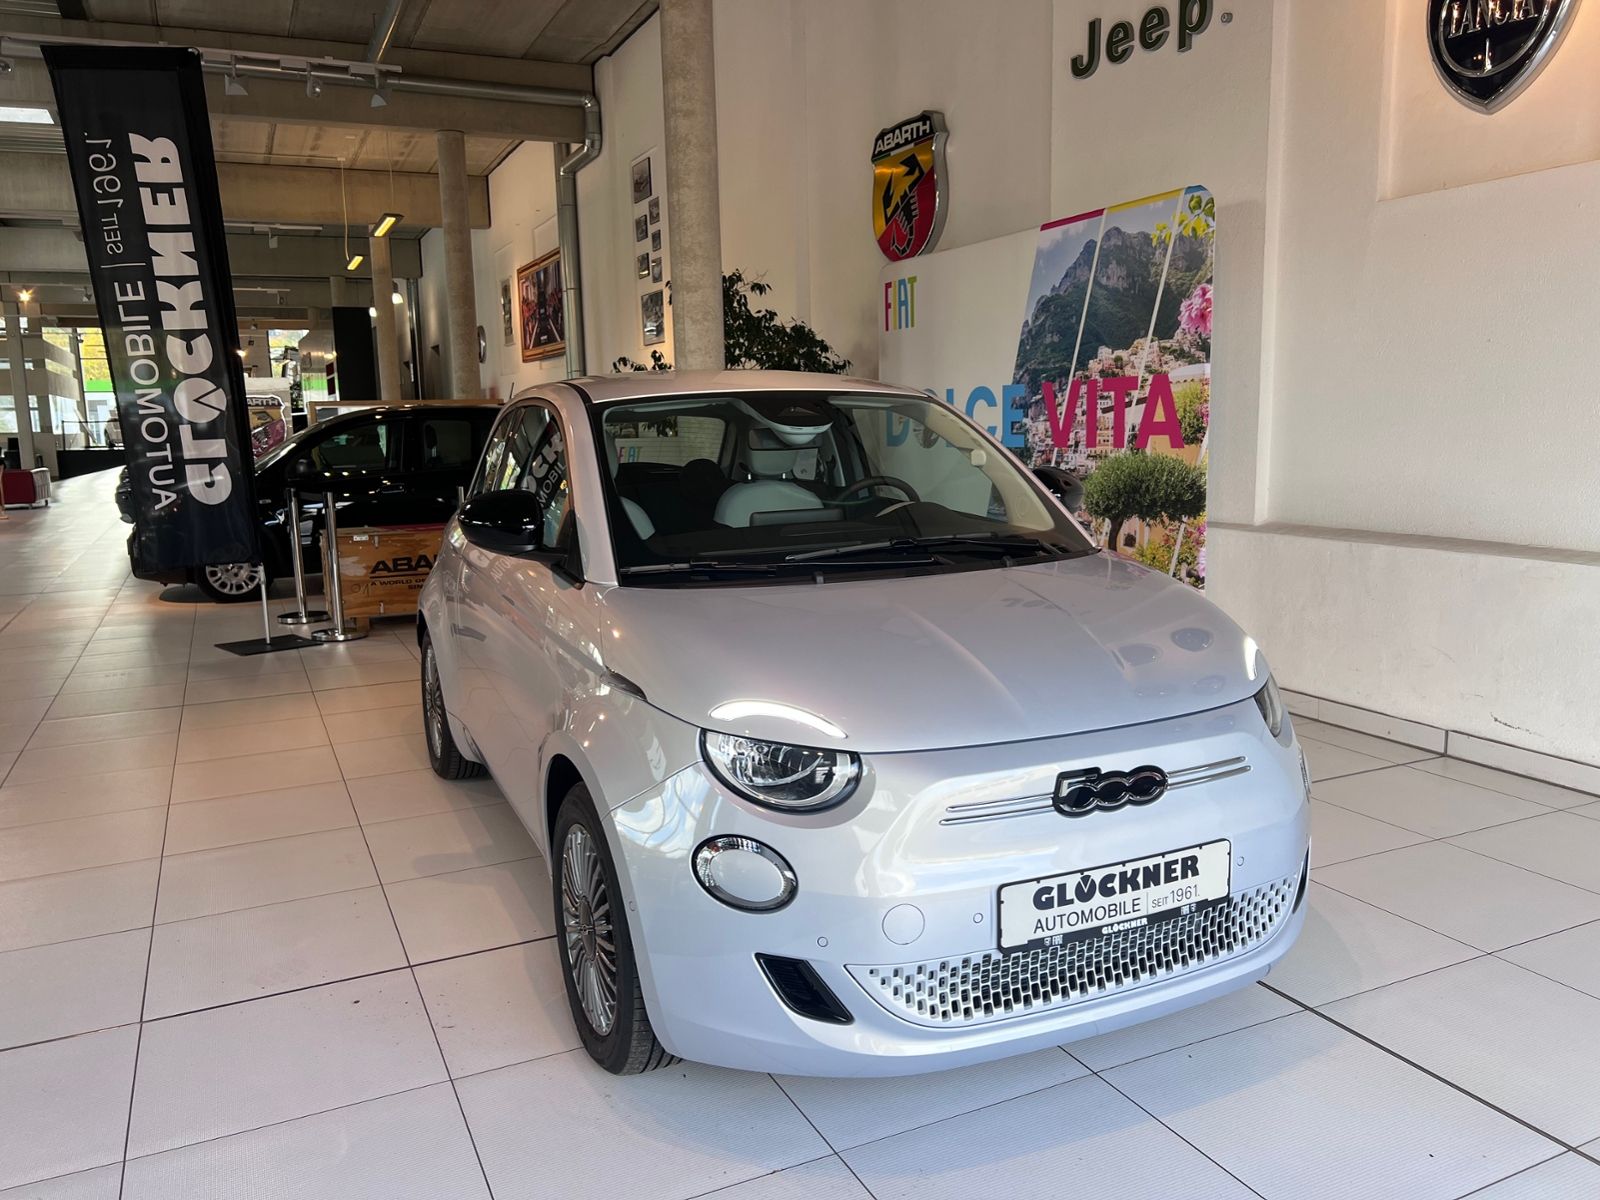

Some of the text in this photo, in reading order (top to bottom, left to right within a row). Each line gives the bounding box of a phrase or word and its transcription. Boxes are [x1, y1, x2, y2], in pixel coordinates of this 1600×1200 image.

[1071, 0, 1213, 79] Jeep
[875, 120, 930, 154] ABARTH
[884, 276, 917, 331] FIAT
[1042, 374, 1185, 449] VITA
[370, 554, 438, 574] ABA
[1052, 765, 1168, 818] 500
[1033, 897, 1141, 934] AUTOMOBILE
[1152, 896, 1168, 908] SEIT
